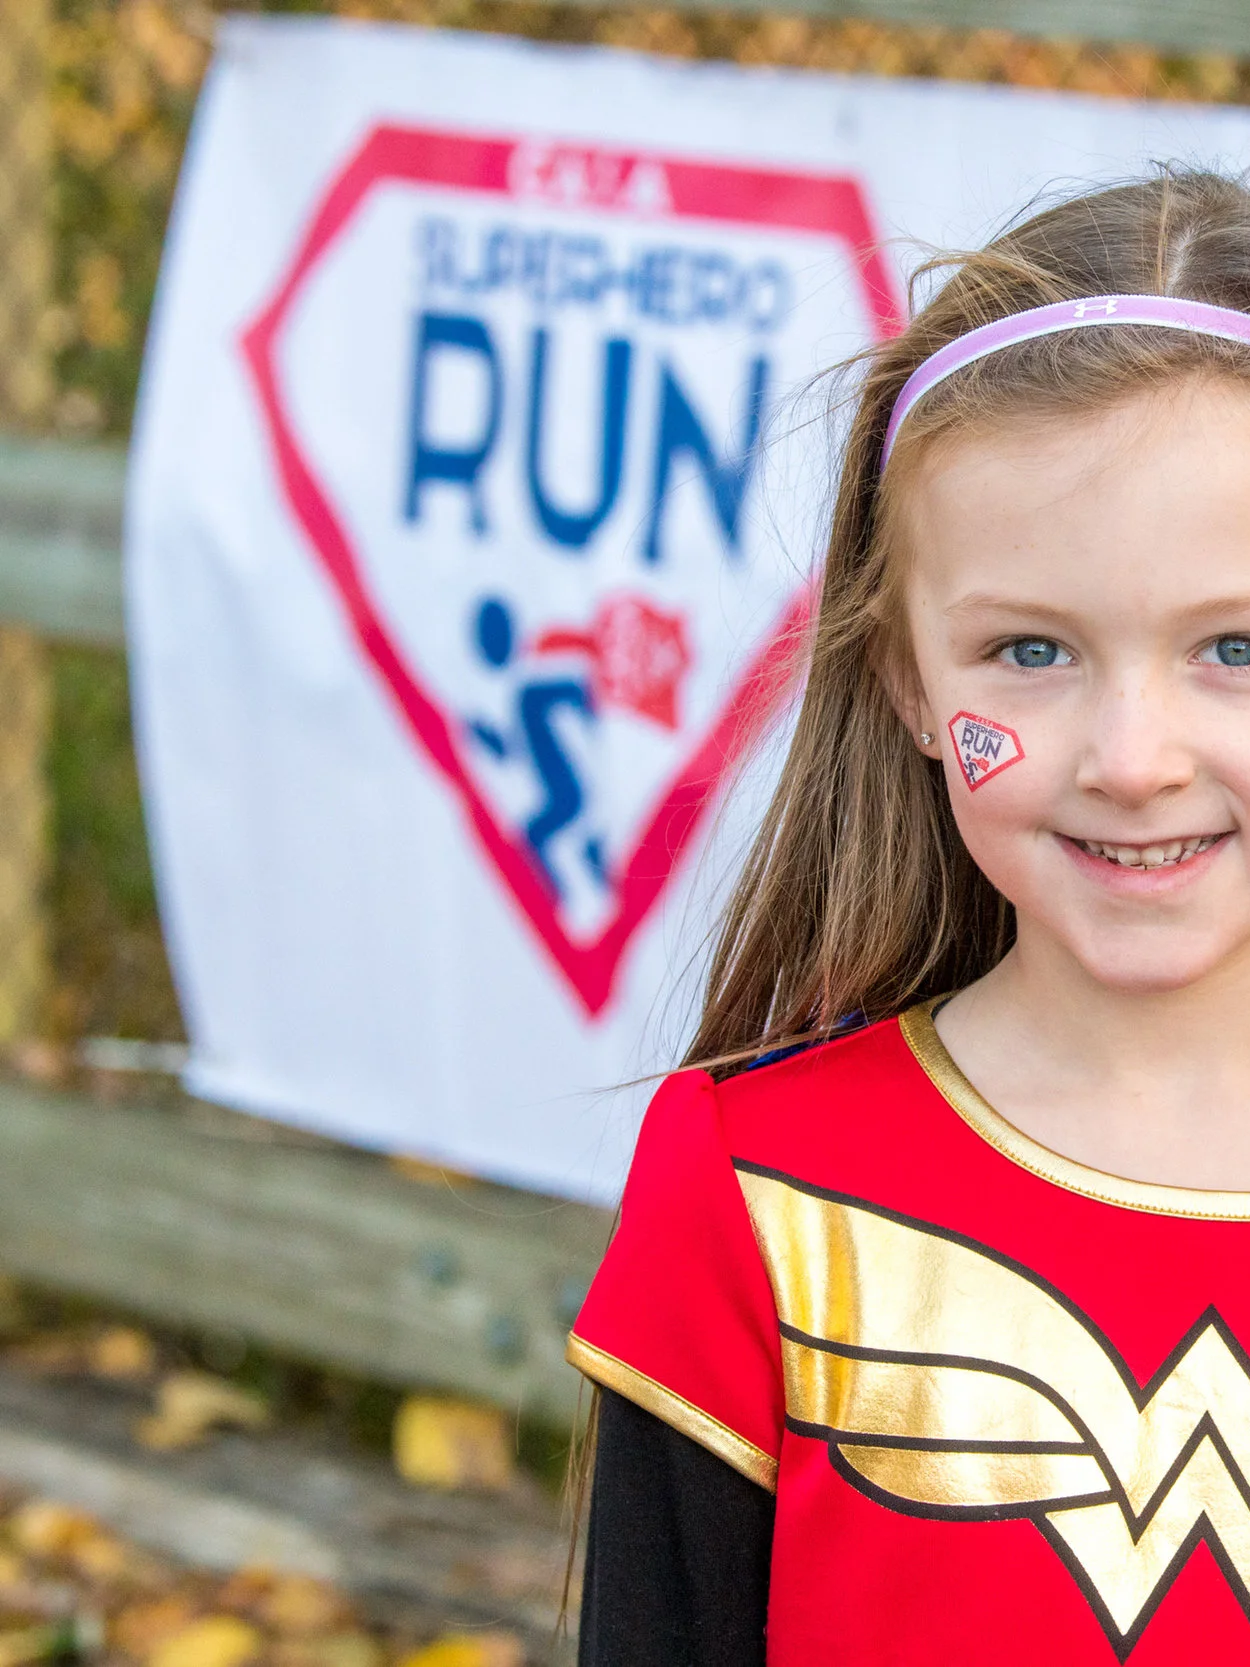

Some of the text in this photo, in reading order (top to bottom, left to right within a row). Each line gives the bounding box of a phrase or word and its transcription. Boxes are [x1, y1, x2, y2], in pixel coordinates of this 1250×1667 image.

[398, 309, 771, 567] RUN
[961, 727, 1002, 760] RUN
[965, 720, 1005, 741] SUPERHERO
